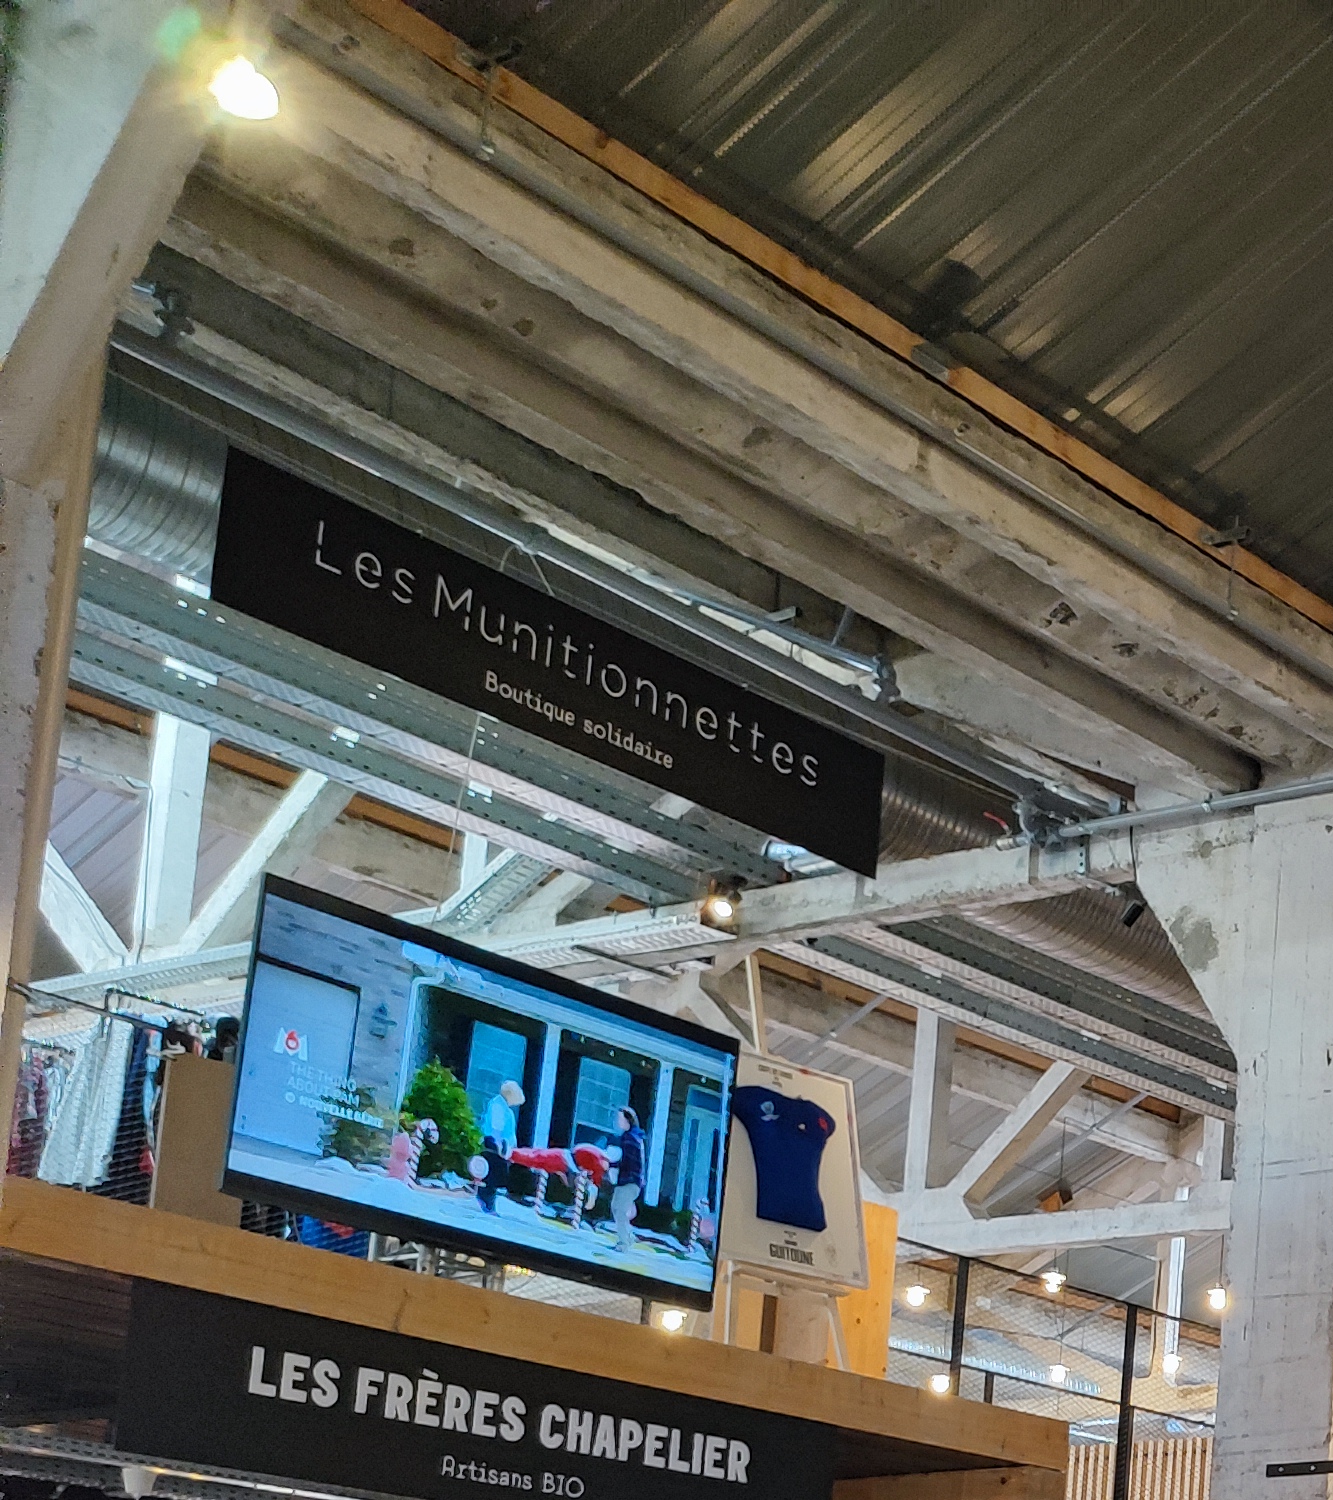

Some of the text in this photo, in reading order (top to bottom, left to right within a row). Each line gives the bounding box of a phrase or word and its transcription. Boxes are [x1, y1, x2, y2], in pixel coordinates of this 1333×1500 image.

[314, 519, 821, 787] Les Munitionnettes
[485, 670, 674, 769] Boutique solidaire
[248, 1344, 753, 1484] LES FRÈRES CHAPELIER
[441, 1454, 585, 1499] Artisans BIO
